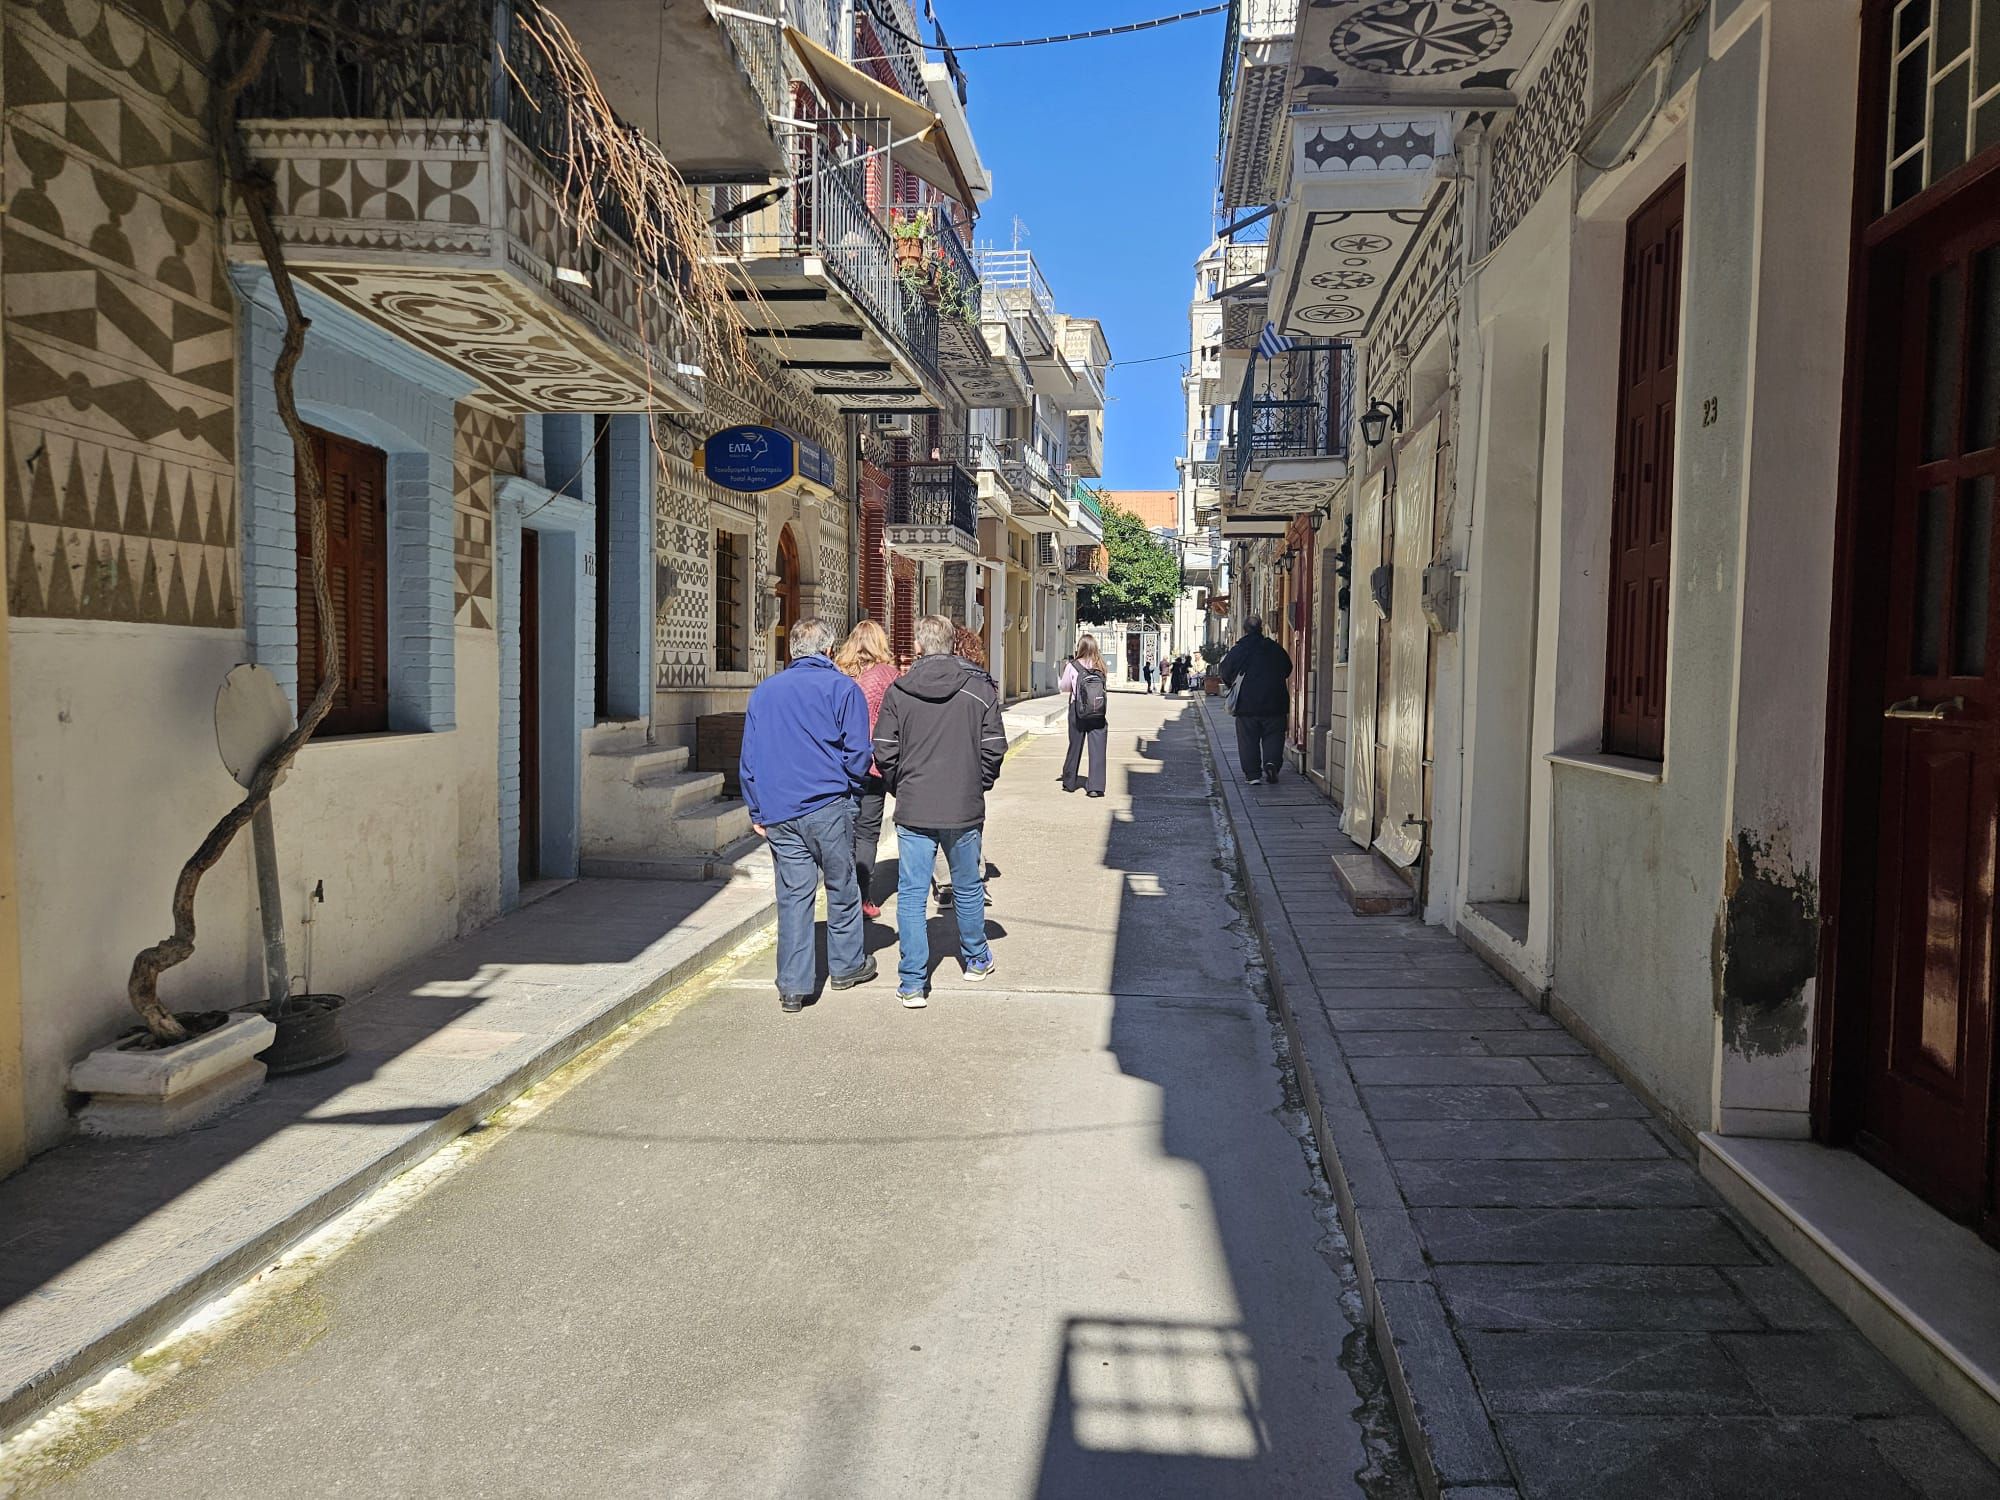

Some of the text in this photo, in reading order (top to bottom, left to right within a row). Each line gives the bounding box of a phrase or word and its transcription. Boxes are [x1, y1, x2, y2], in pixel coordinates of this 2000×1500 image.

[1702, 396, 1717, 427] 23
[728, 443, 752, 453] ΕΛΤΑ
[584, 554, 594, 576] 18
